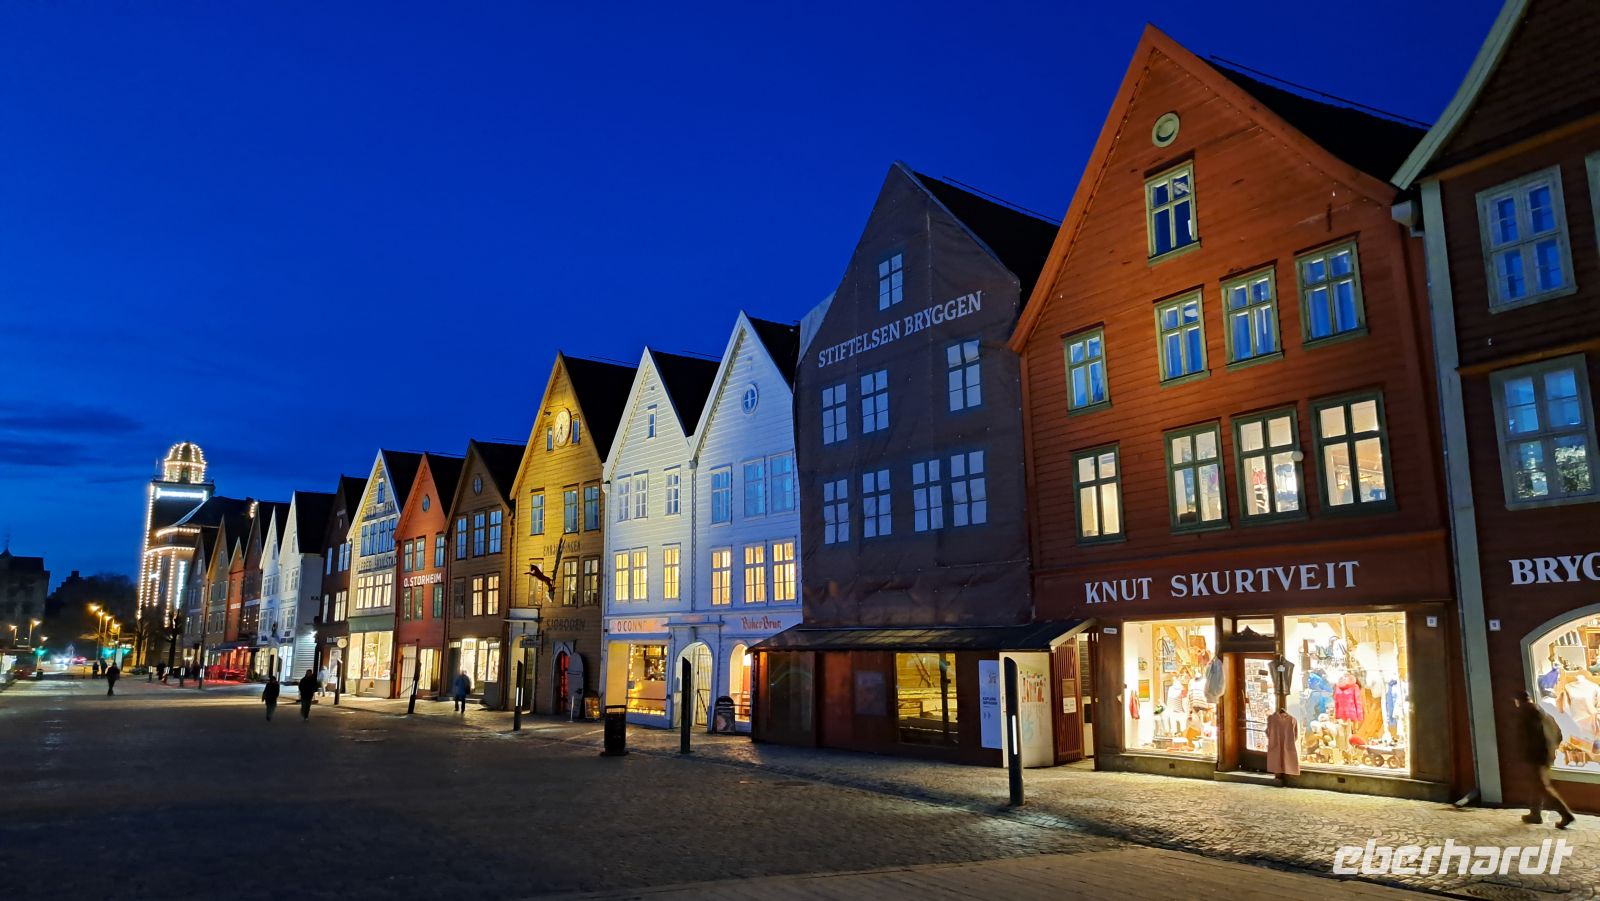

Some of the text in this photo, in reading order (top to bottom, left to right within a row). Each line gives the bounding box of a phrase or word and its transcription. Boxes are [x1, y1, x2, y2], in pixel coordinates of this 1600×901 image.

[818, 290, 982, 368] STIFTELSEN BRYGGEN
[1084, 560, 1360, 604] KNUT SKURTVEIT
[1508, 551, 1600, 585] BRYG
